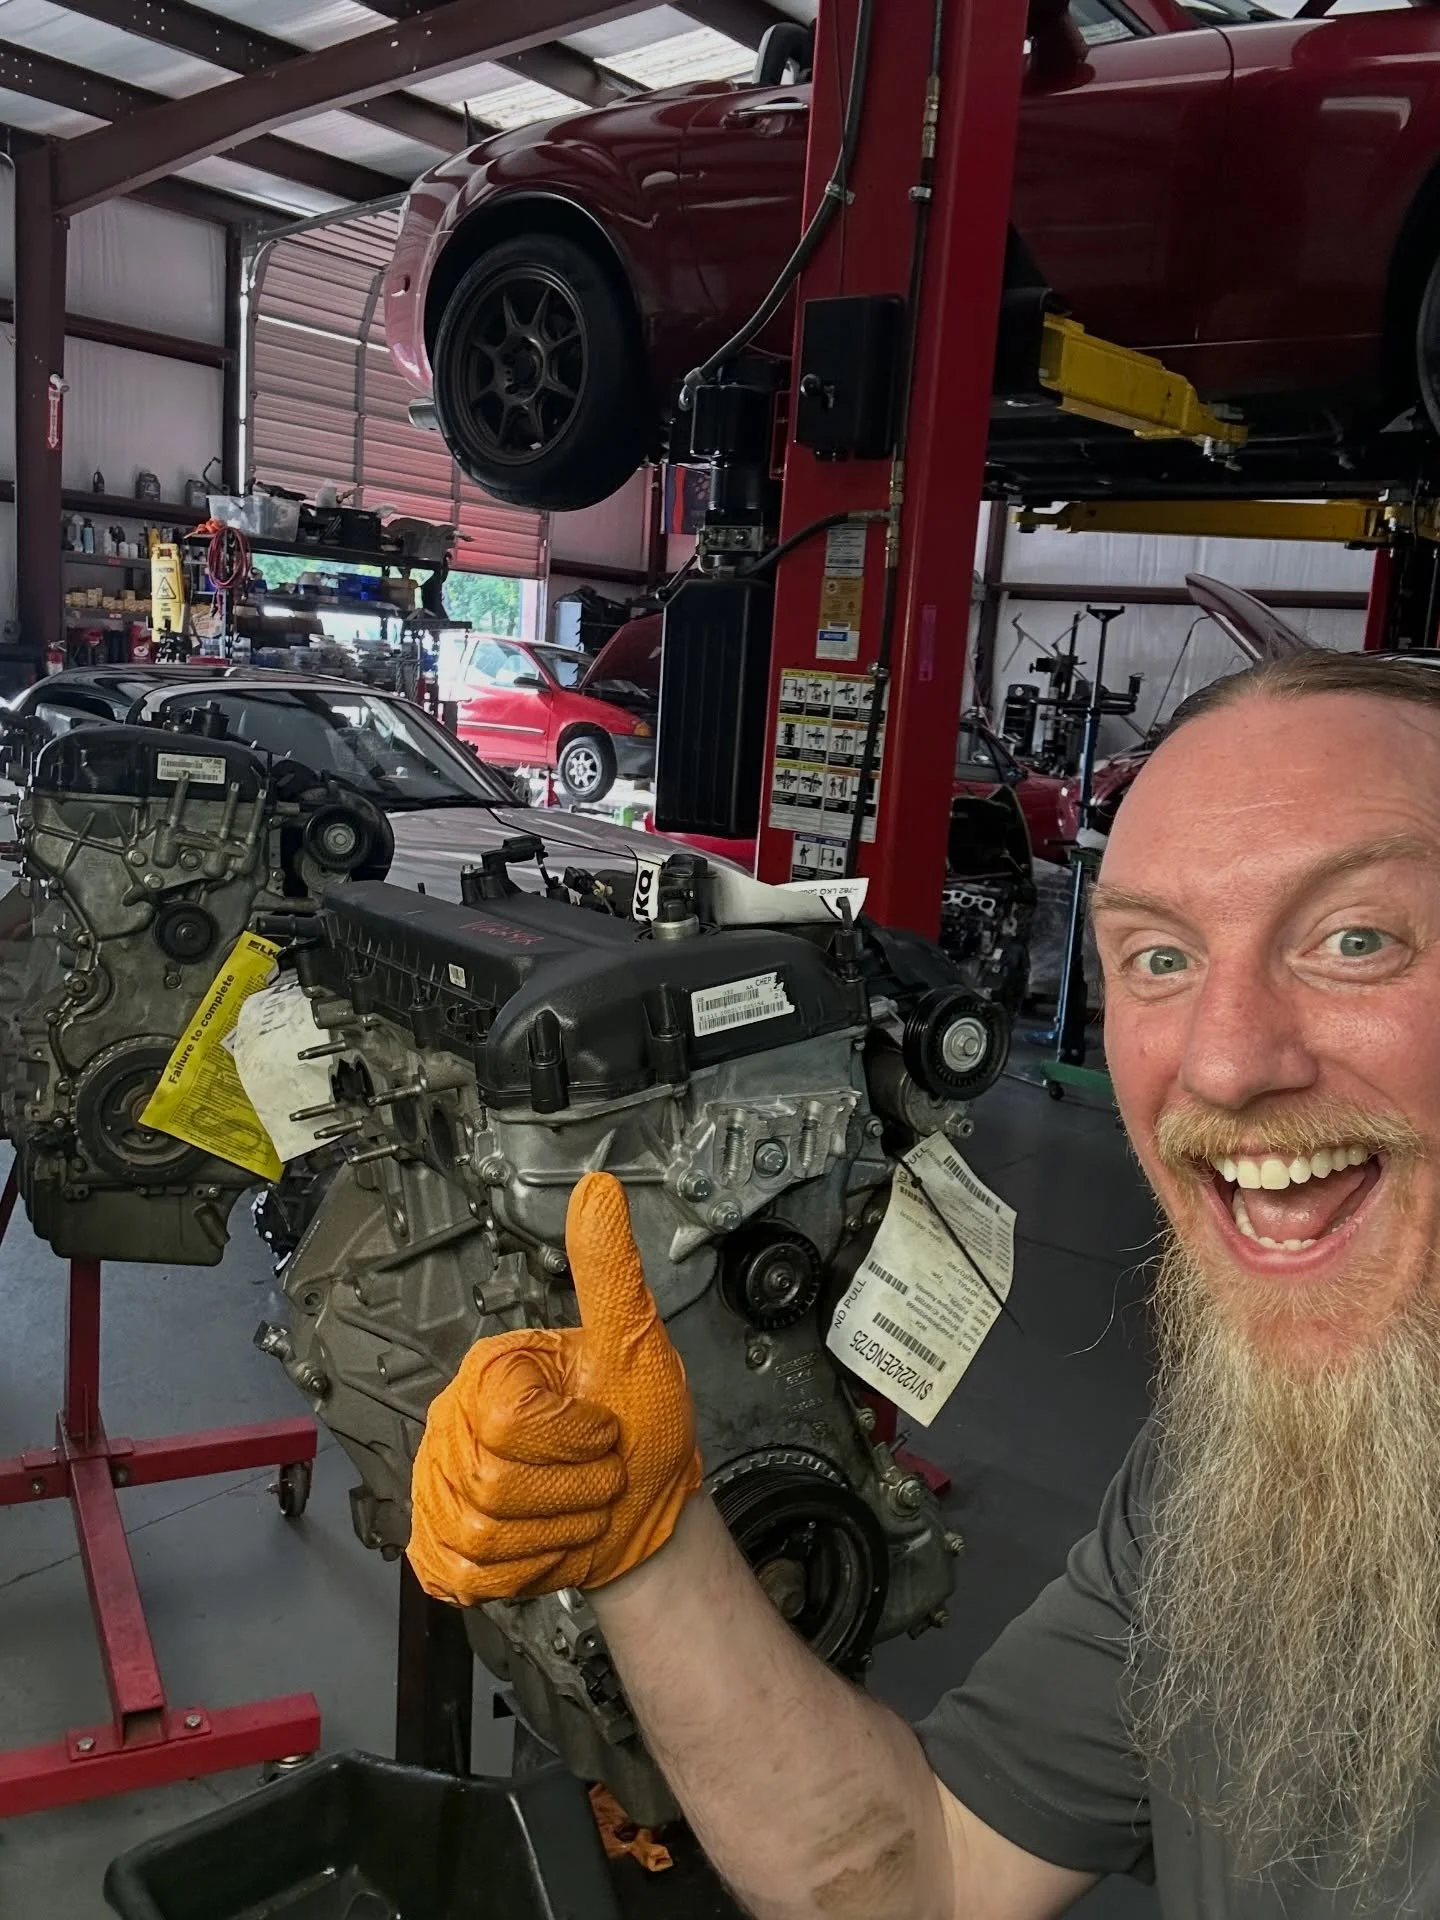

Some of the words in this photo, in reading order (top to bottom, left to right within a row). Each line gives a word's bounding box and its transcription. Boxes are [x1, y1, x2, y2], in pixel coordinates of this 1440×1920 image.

[636, 870, 654, 921] KQ
[168, 1043, 195, 1085] Failure
[191, 1030, 203, 1042] to
[201, 974, 235, 1028] complete
[842, 1277, 868, 1309] PULL
[848, 1329, 934, 1401] SV12242ENG725
